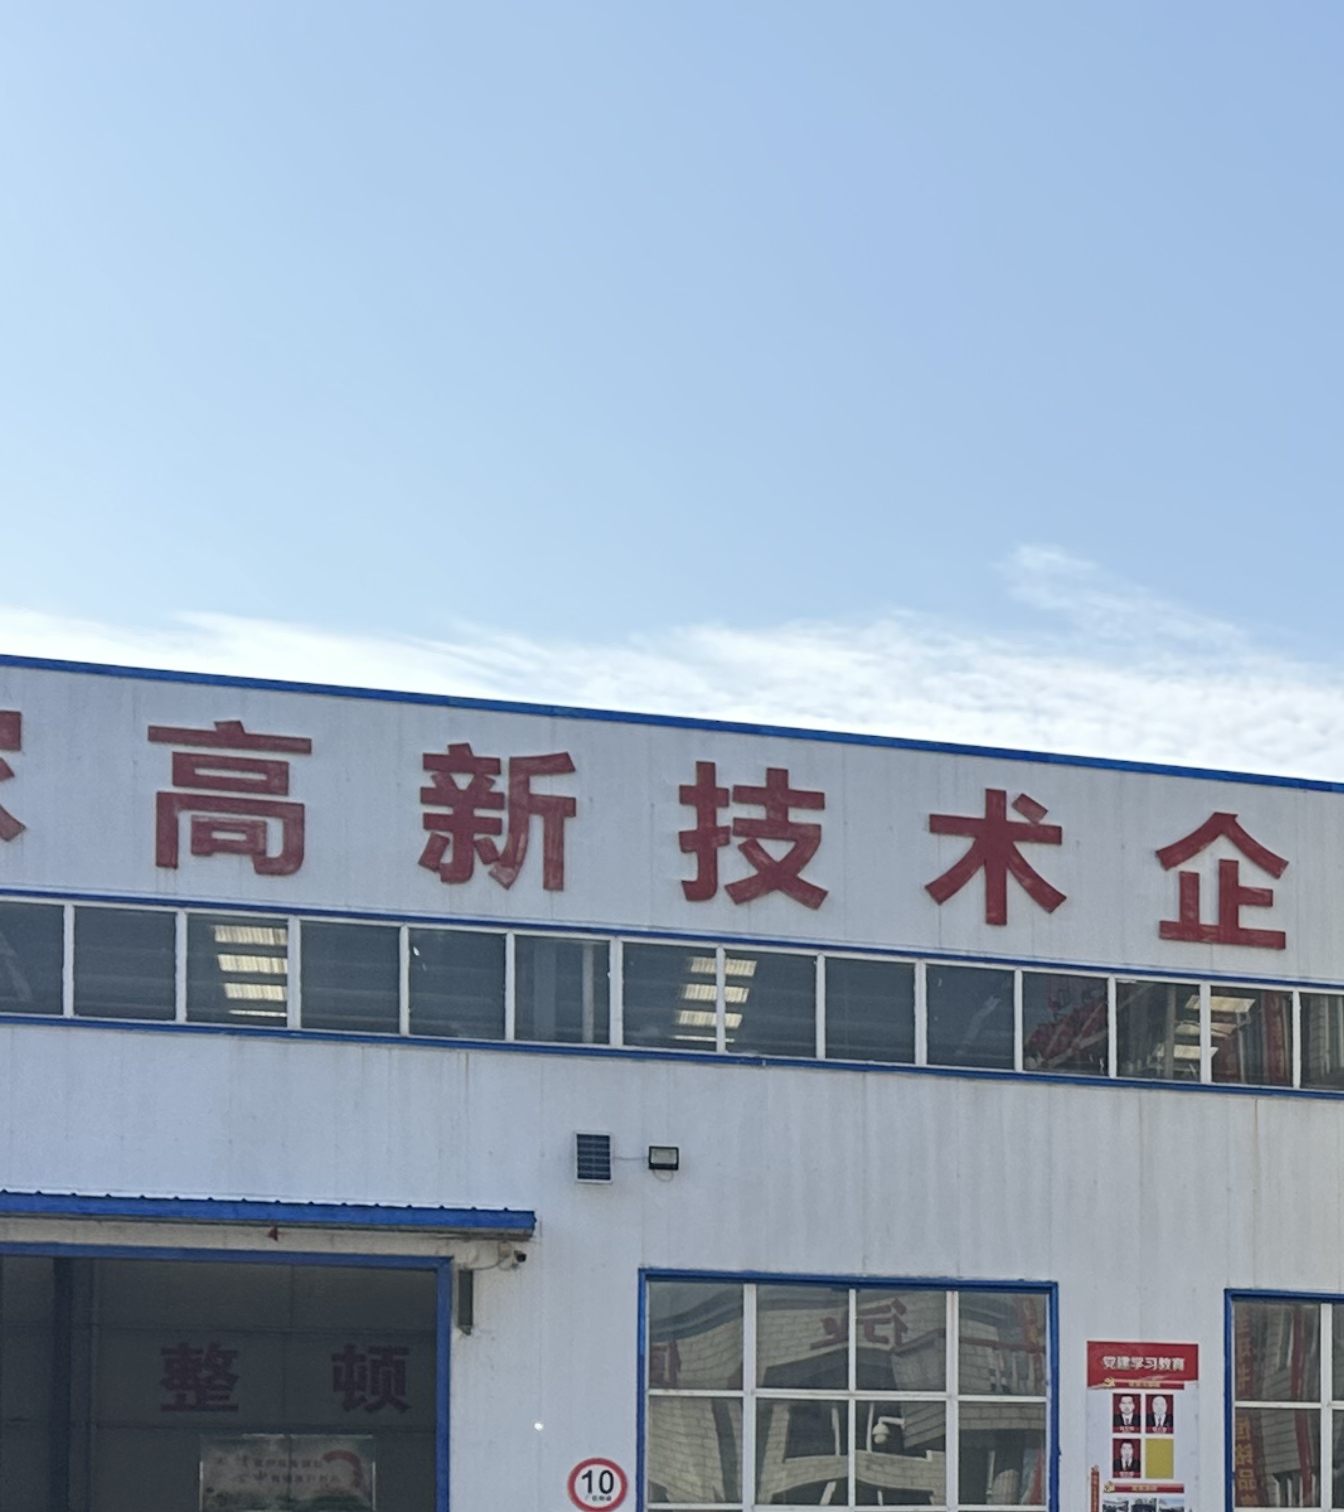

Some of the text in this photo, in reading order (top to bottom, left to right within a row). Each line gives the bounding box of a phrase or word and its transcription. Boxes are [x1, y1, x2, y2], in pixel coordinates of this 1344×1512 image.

[1102, 1356, 1185, 1372] 党建学习教育
[159, 1341, 411, 1414] 整顿
[581, 1470, 614, 1494] 10
